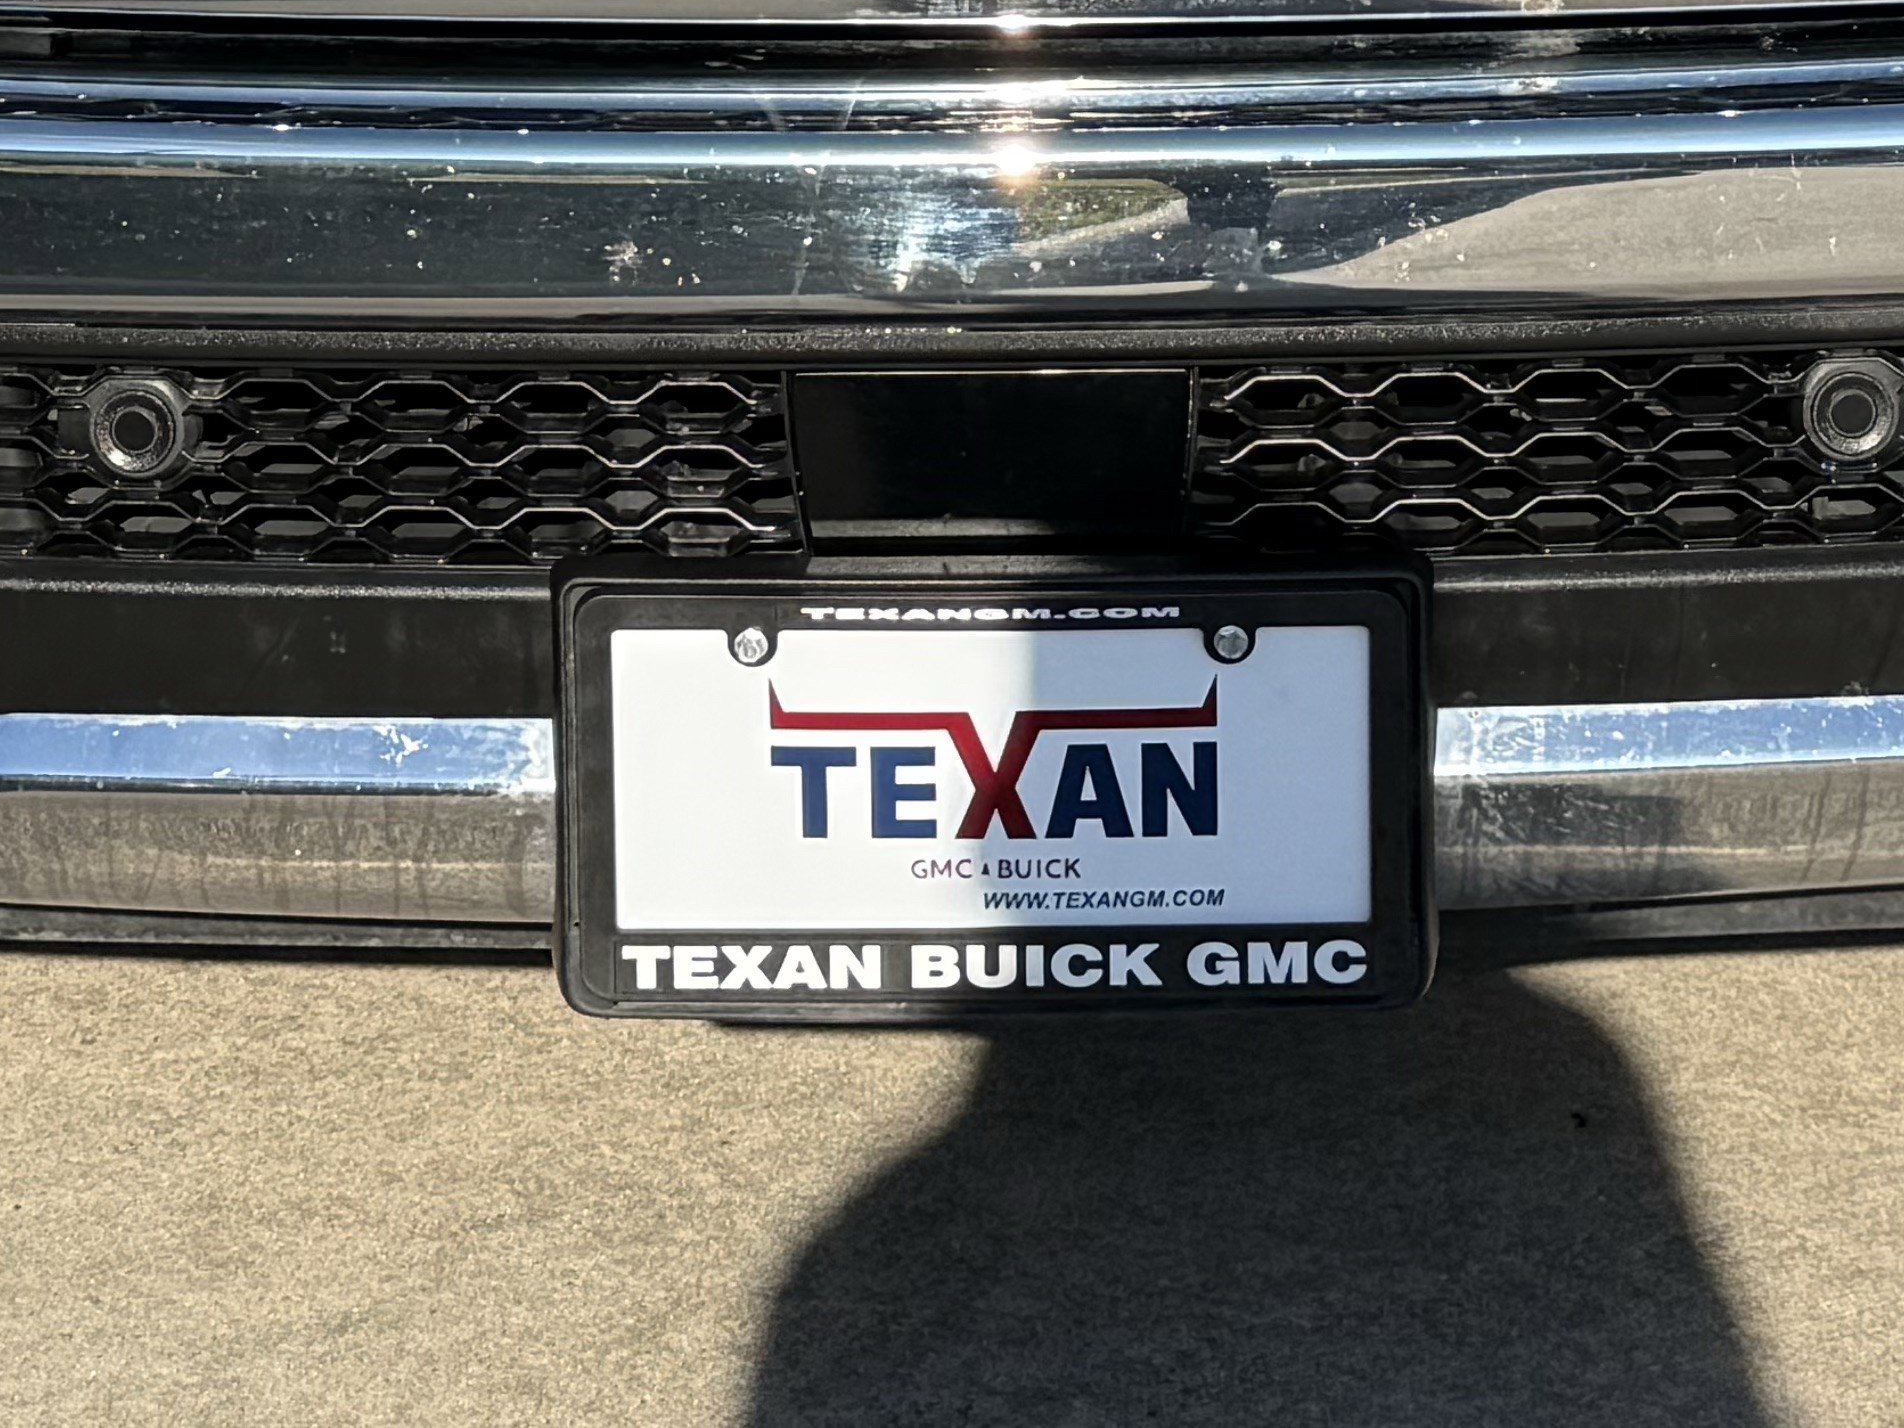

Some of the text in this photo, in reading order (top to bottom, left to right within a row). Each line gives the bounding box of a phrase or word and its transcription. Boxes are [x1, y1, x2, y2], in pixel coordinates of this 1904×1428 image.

[800, 606, 1180, 621] TEXANGM.COM
[769, 710, 1218, 841] TEXAN
[911, 858, 1082, 880] GMC BUICK
[983, 888, 1226, 910] WWW.TEXANGM.COM
[622, 939, 1368, 991] TEXAN BUICK GMC
